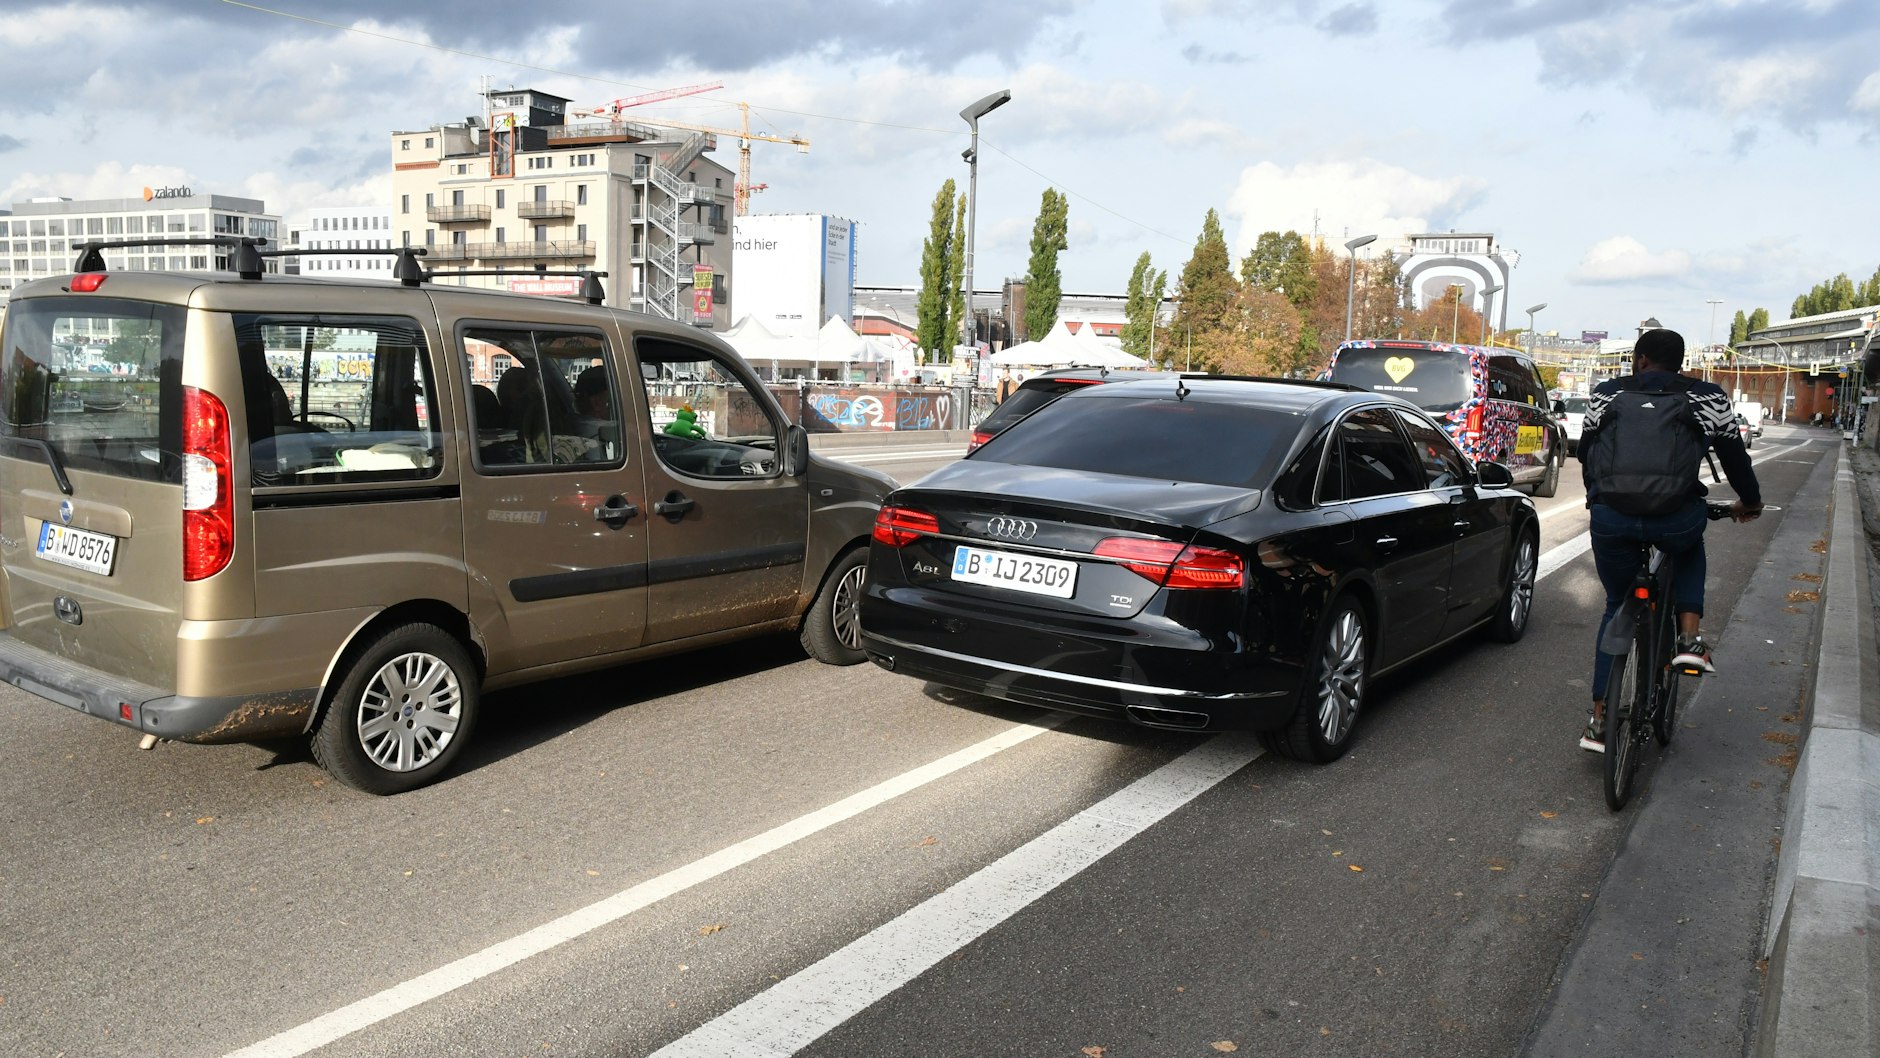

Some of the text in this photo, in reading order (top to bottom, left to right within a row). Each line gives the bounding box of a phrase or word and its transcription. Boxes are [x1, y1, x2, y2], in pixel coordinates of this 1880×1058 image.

[154, 184, 191, 199] zalando
[755, 238, 778, 250] hier
[1391, 364, 1406, 372] BVG
[46, 528, 56, 551] B
[62, 531, 79, 556] WD
[79, 536, 110, 565] 8576
[968, 553, 1070, 588] B IJ 2309
[1110, 594, 1132, 604] TDI
